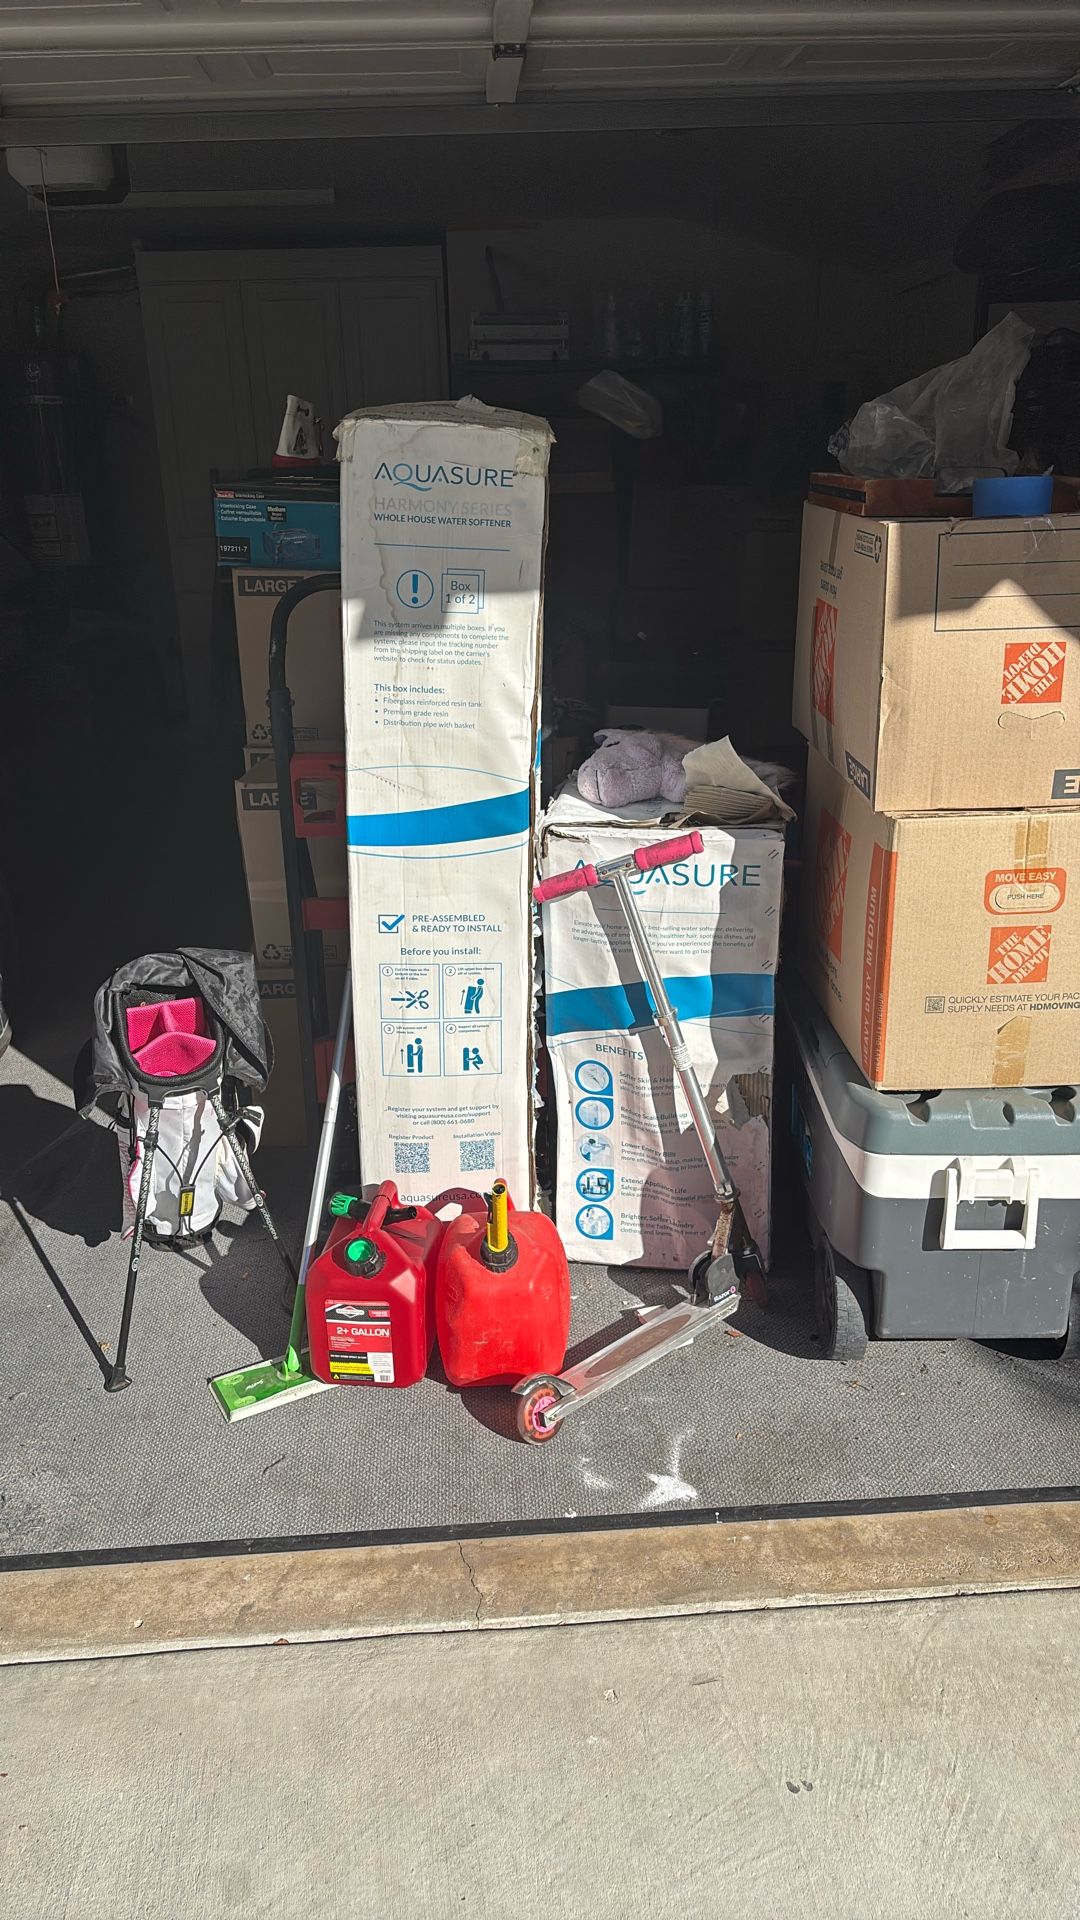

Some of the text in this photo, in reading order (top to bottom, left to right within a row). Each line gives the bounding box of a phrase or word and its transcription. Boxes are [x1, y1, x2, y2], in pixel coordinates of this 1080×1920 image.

[374, 462, 514, 491] AQUASURE
[374, 497, 512, 516] HARMONY SERIES
[374, 514, 511, 528] WHOLE HOUSE WATER SOFTENER
[450, 581, 470, 591] Box
[446, 594, 476, 605] 1 of 2
[388, 621, 410, 630] system
[385, 629, 407, 637] missing
[449, 641, 473, 649] tracking
[1003, 642, 1043, 682] DEPOT
[1002, 642, 1066, 705] HOME
[374, 683, 391, 692] This
[409, 686, 445, 694] includes:
[1031, 673, 1058, 697] THE
[384, 697, 415, 706] Fiberglass
[384, 719, 421, 727] Distribution
[995, 871, 1056, 883] MOVE EASY
[995, 932, 1021, 957] THE
[987, 925, 1052, 984] HOME
[1010, 946, 1049, 983] DEPOT
[862, 886, 878, 1064] HEAVY DUTY MEDIUM
[948, 996, 988, 1004] QUICKLY
[990, 994, 1032, 1003] ESTIMATE
[1036, 993, 1060, 1002] YOUR
[947, 1004, 982, 1013] SUPPLY
[984, 1004, 1014, 1012] NEEDS
[1030, 1002, 1080, 1011] HDMOVING
[596, 1044, 644, 1060] BENEFITS
[622, 1141, 640, 1149] Lower
[400, 1192, 488, 1204] aquasureusa.co
[337, 1327, 390, 1336] 2+ GALLON
